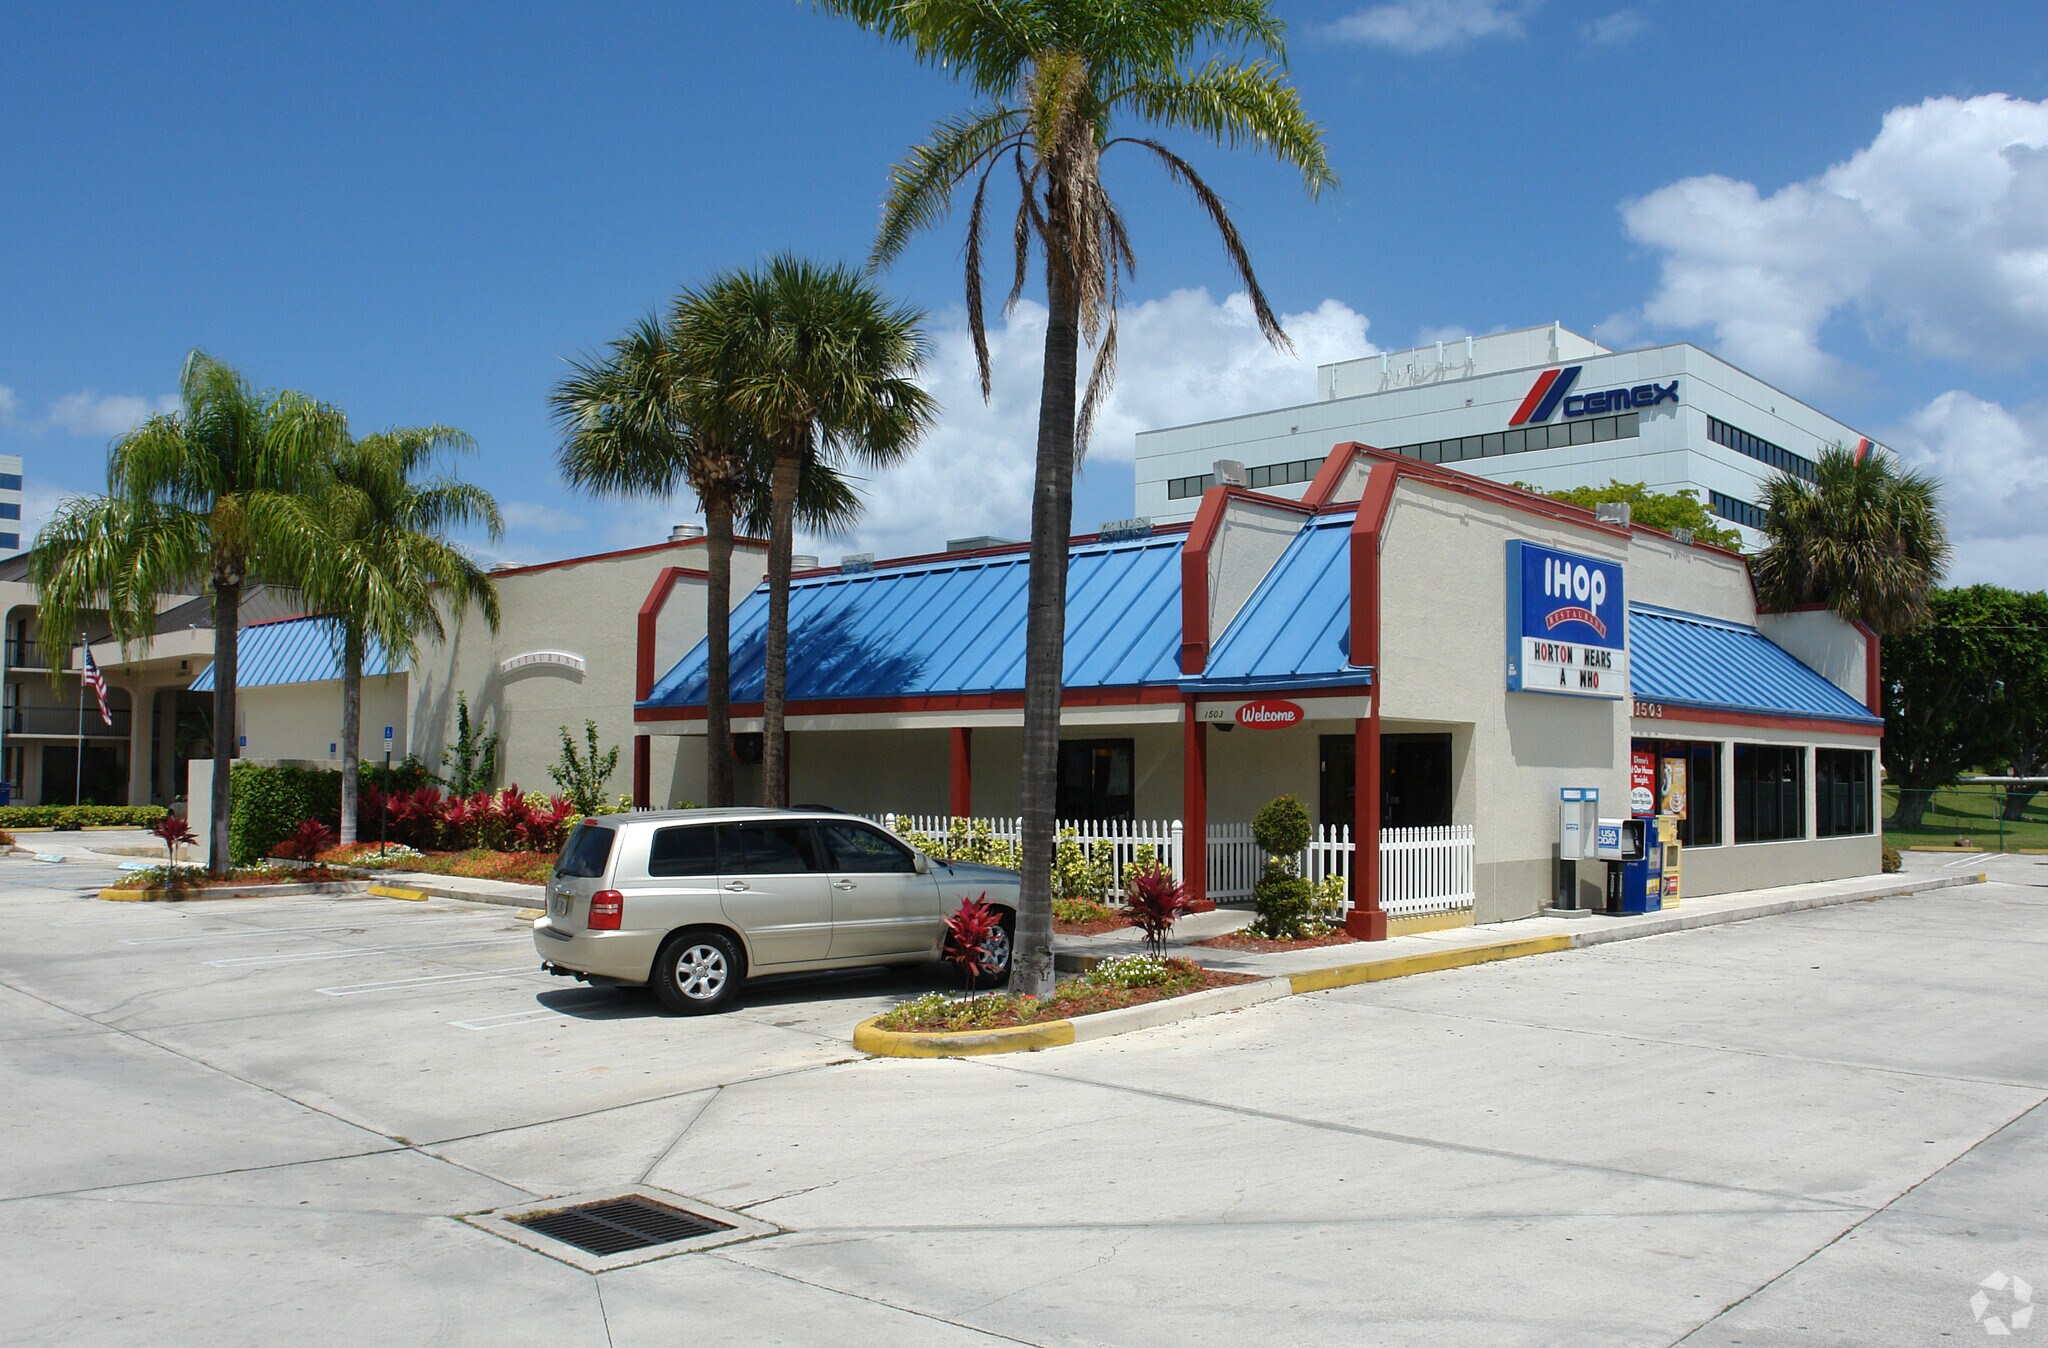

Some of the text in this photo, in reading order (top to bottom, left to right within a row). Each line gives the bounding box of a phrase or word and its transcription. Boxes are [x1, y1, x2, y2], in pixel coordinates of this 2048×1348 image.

[1563, 380, 1680, 417] CEMEX
[1544, 557, 1606, 616] IHOP
[1548, 608, 1604, 636] RESTAURANT
[501, 653, 580, 673] RESTAURANT
[1534, 642, 1612, 669] HORTON HEARS
[1559, 667, 1600, 689] A WHO
[1204, 709, 1225, 719] 1503
[1241, 705, 1296, 723] Welcome
[1635, 701, 1663, 719] 1503
[1598, 836, 1618, 845] ODAY
[1601, 829, 1617, 837] USA
